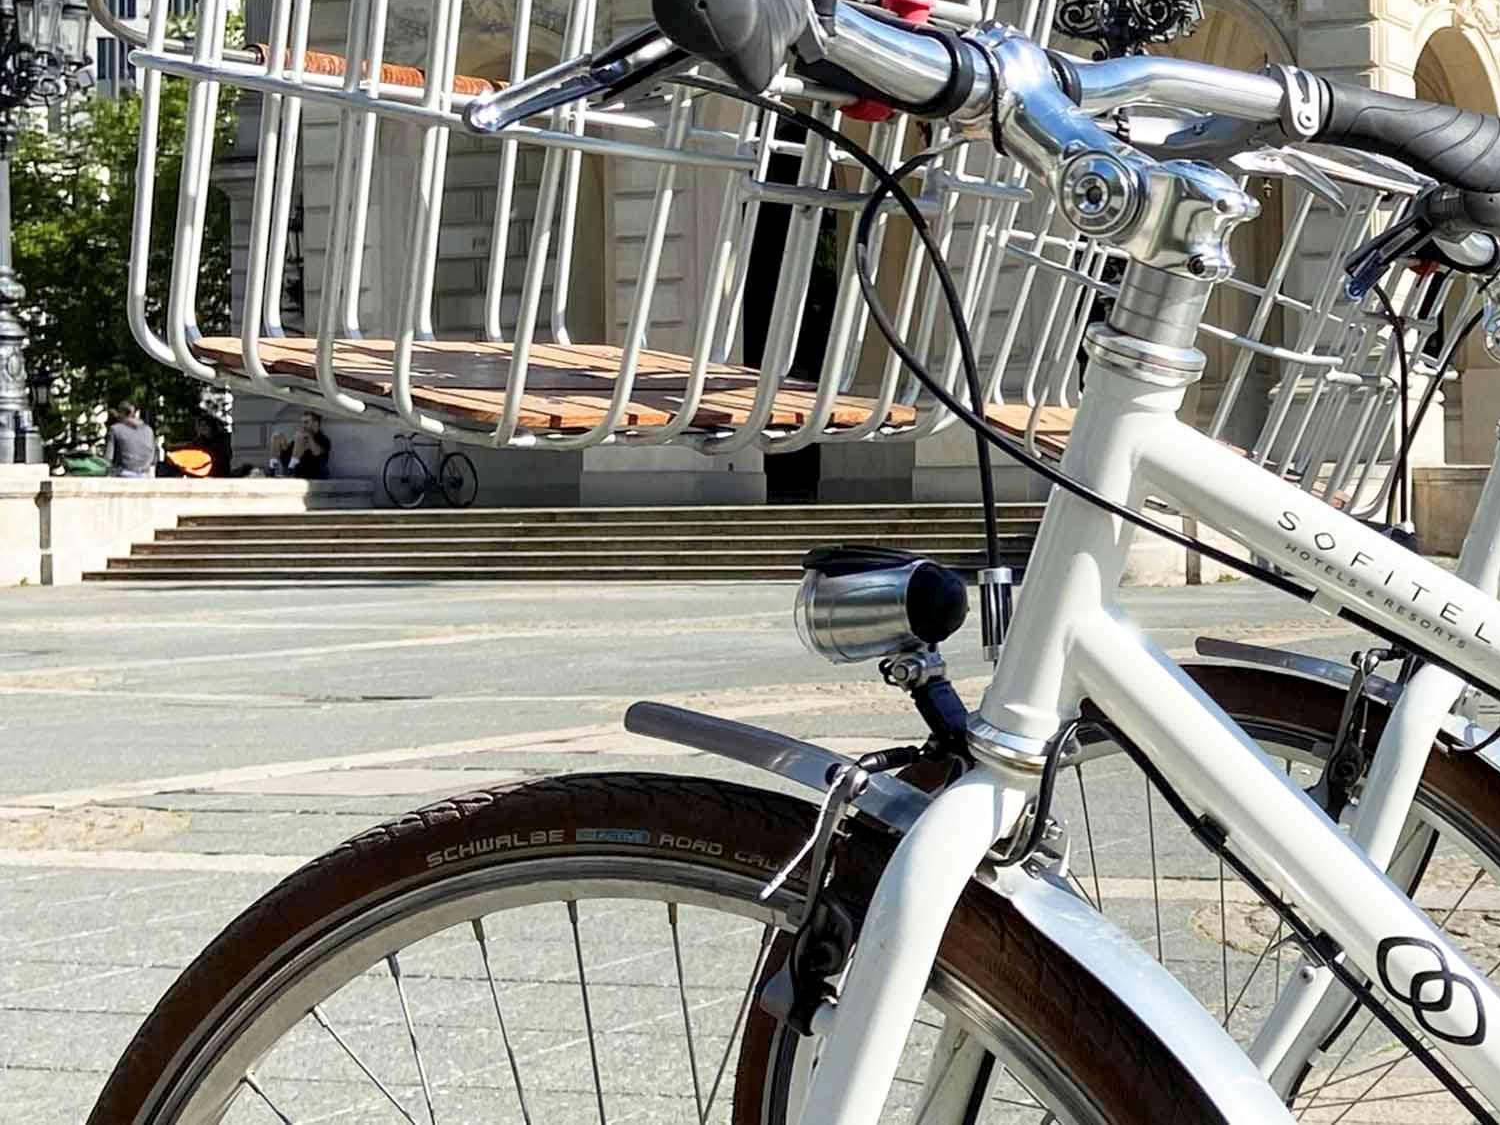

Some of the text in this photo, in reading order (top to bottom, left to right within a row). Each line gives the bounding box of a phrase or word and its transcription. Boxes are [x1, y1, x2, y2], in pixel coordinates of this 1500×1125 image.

[1276, 510, 1492, 645] SOFITEL
[1284, 542, 1468, 649] HOTELS & RESORTS
[425, 828, 566, 868] SCHWALBE
[658, 833, 724, 856] ROAD
